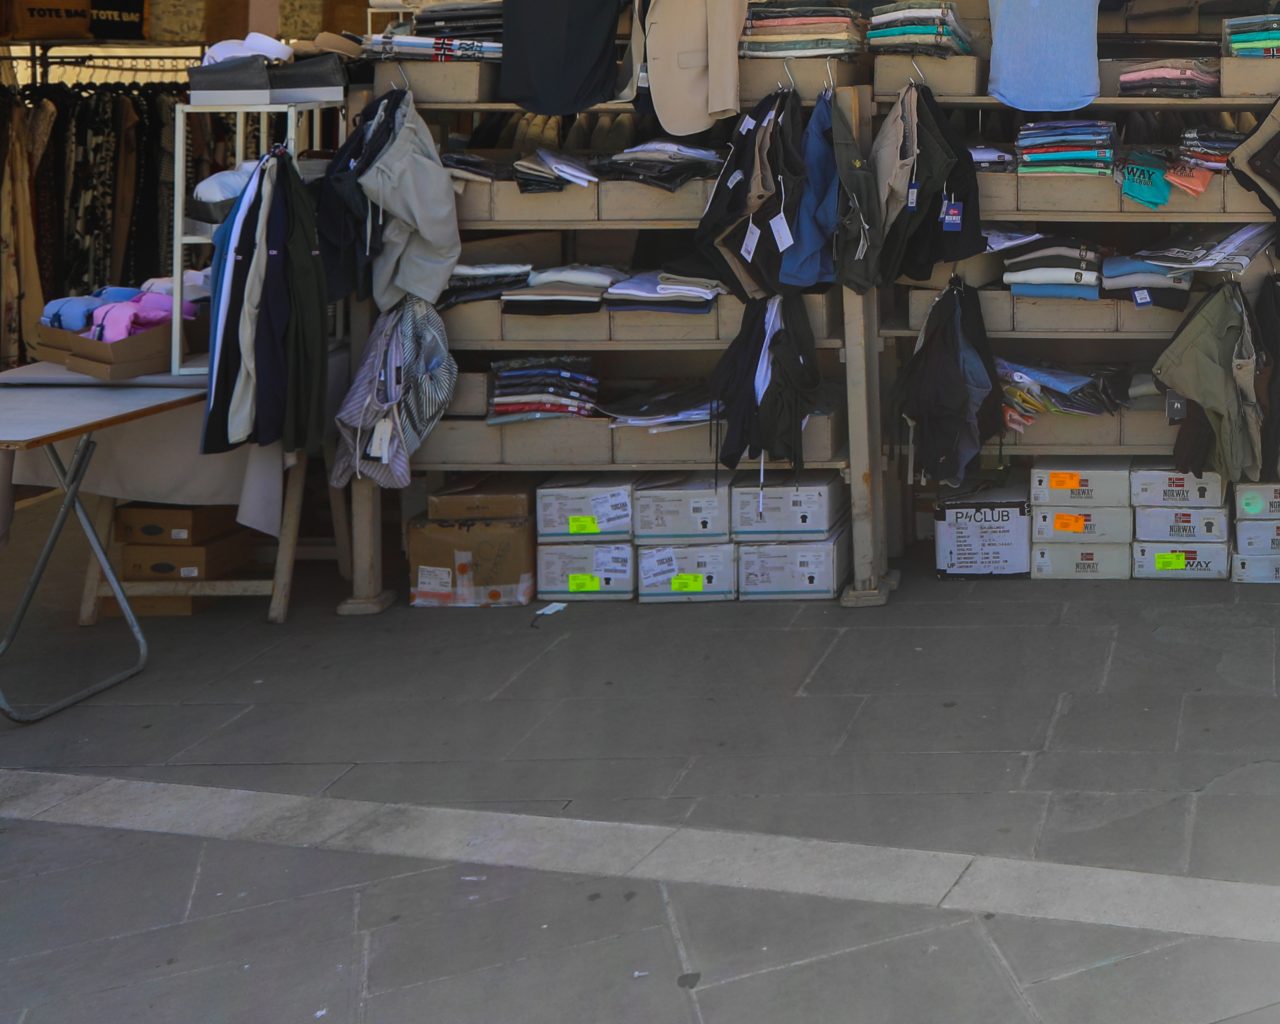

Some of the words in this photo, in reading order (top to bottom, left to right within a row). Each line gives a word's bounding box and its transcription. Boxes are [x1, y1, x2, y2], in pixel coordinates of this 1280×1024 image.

[27, 8, 61, 18] TOTE
[90, 10, 119, 21] TOTE
[1126, 166, 1154, 180] WAY
[1163, 489, 1189, 497] NORWAY
[1169, 525, 1196, 533] NORWAY
[1075, 562, 1099, 570] NORWAY
